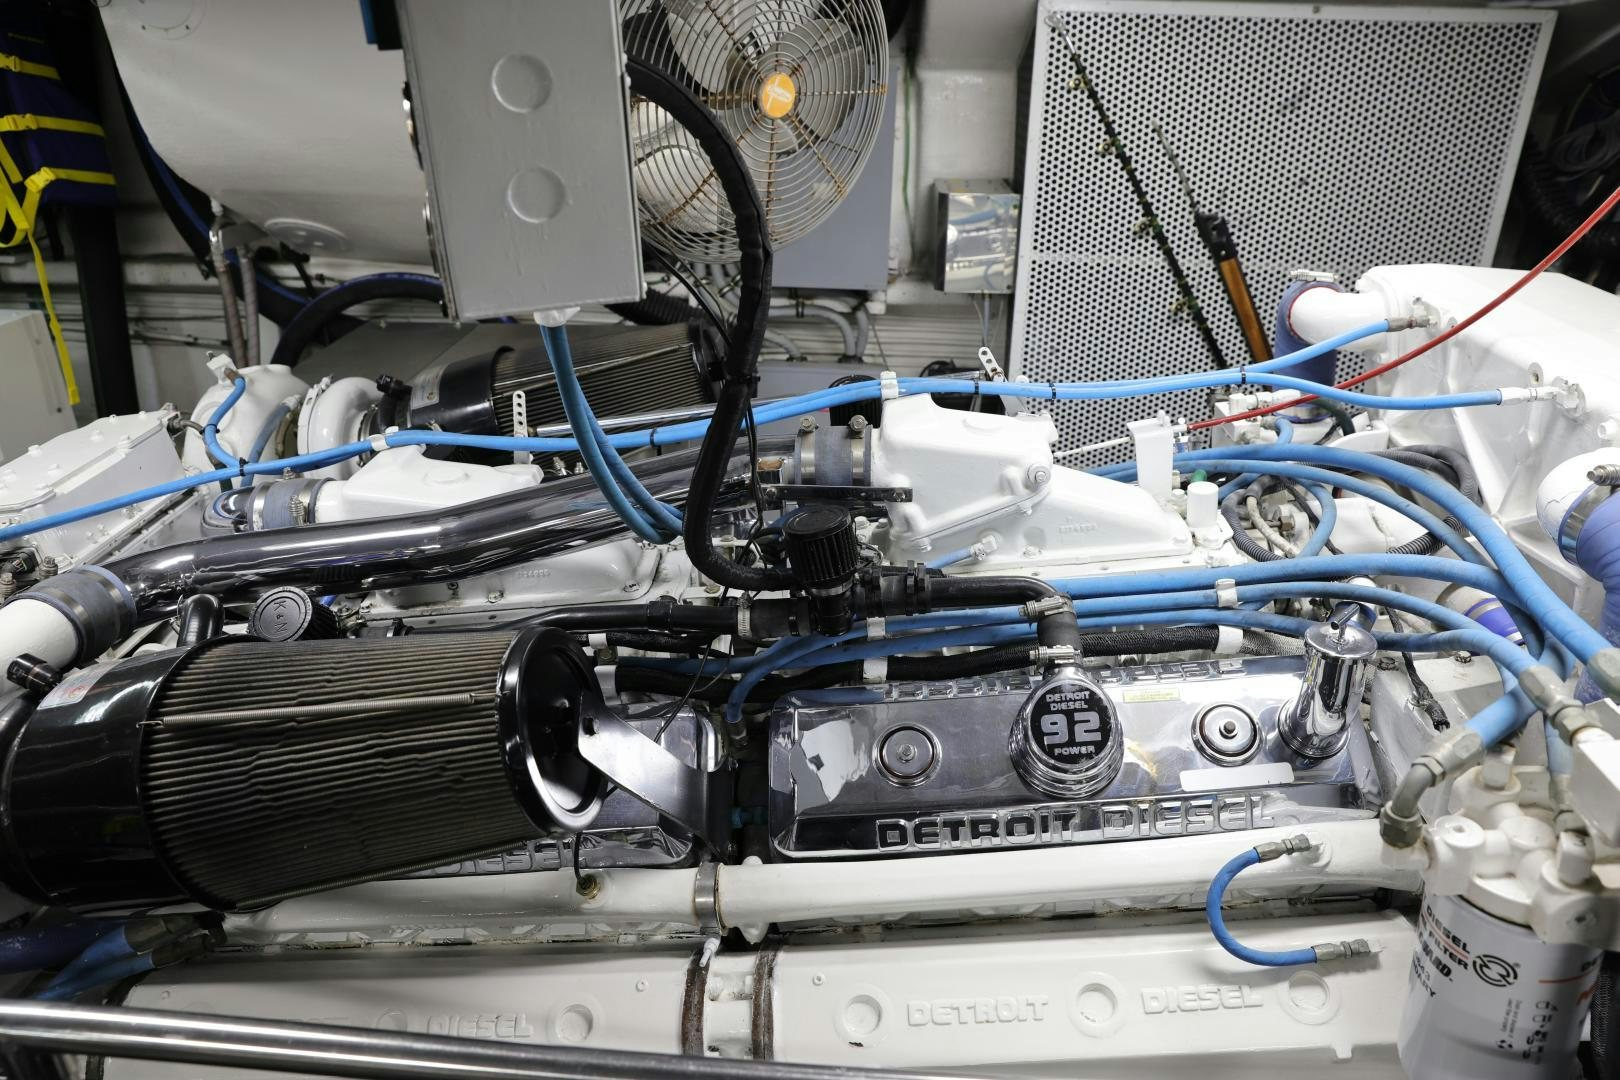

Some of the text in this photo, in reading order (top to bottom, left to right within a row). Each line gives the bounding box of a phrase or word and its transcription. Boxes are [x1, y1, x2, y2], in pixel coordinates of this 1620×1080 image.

[1045, 690, 1091, 702] DETROIT
[1050, 701, 1089, 711] DIESEL
[1040, 711, 1102, 745] 92
[1054, 745, 1096, 756] POWER
[876, 793, 1275, 852] DETROIT DIESEL
[1426, 904, 1470, 954] DIESEL
[906, 984, 1264, 1027] DETROIT DIESEL
